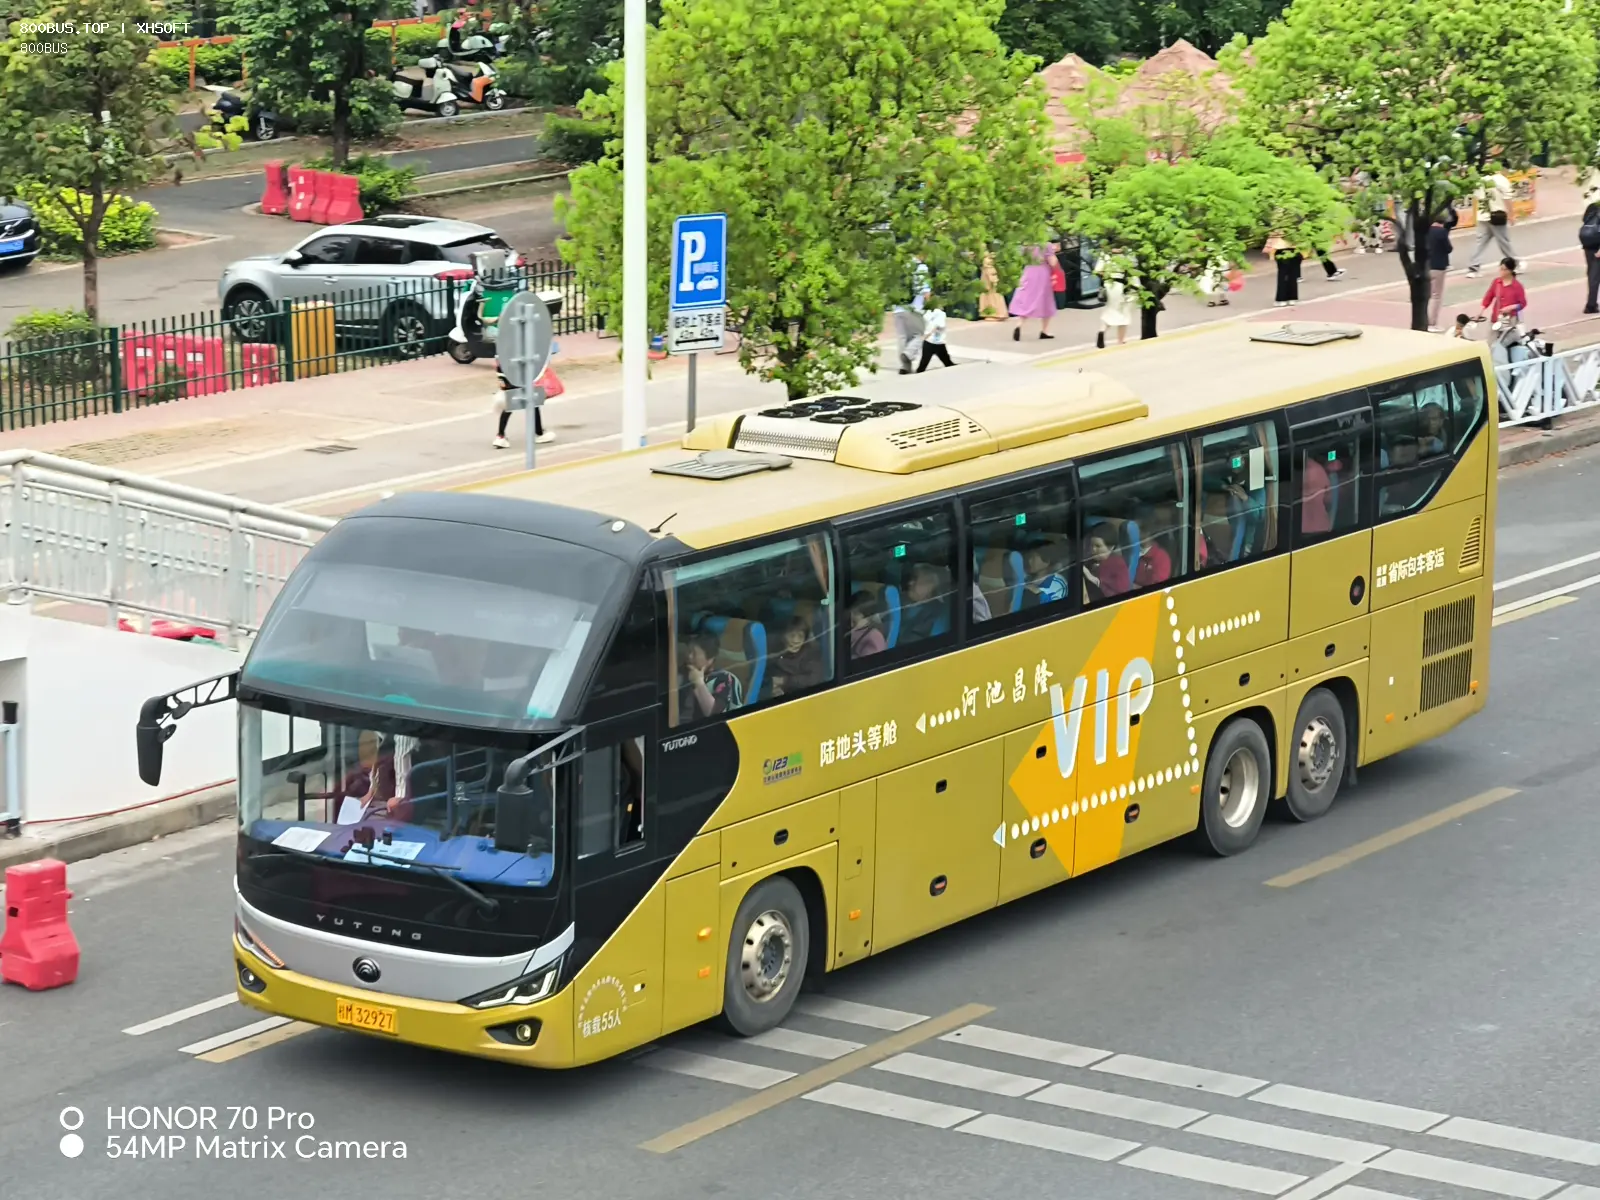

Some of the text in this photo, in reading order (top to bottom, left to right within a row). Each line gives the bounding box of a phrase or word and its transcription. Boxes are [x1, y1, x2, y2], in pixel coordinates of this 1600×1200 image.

[679, 231, 706, 291] P
[1388, 547, 1444, 583] 省际包车客运
[961, 659, 1053, 717] 河池昌隆
[1050, 657, 1154, 779] VIP
[662, 734, 698, 753] YUTONG
[820, 719, 898, 767] 陆地头等舱
[316, 913, 423, 941] YUTONG
